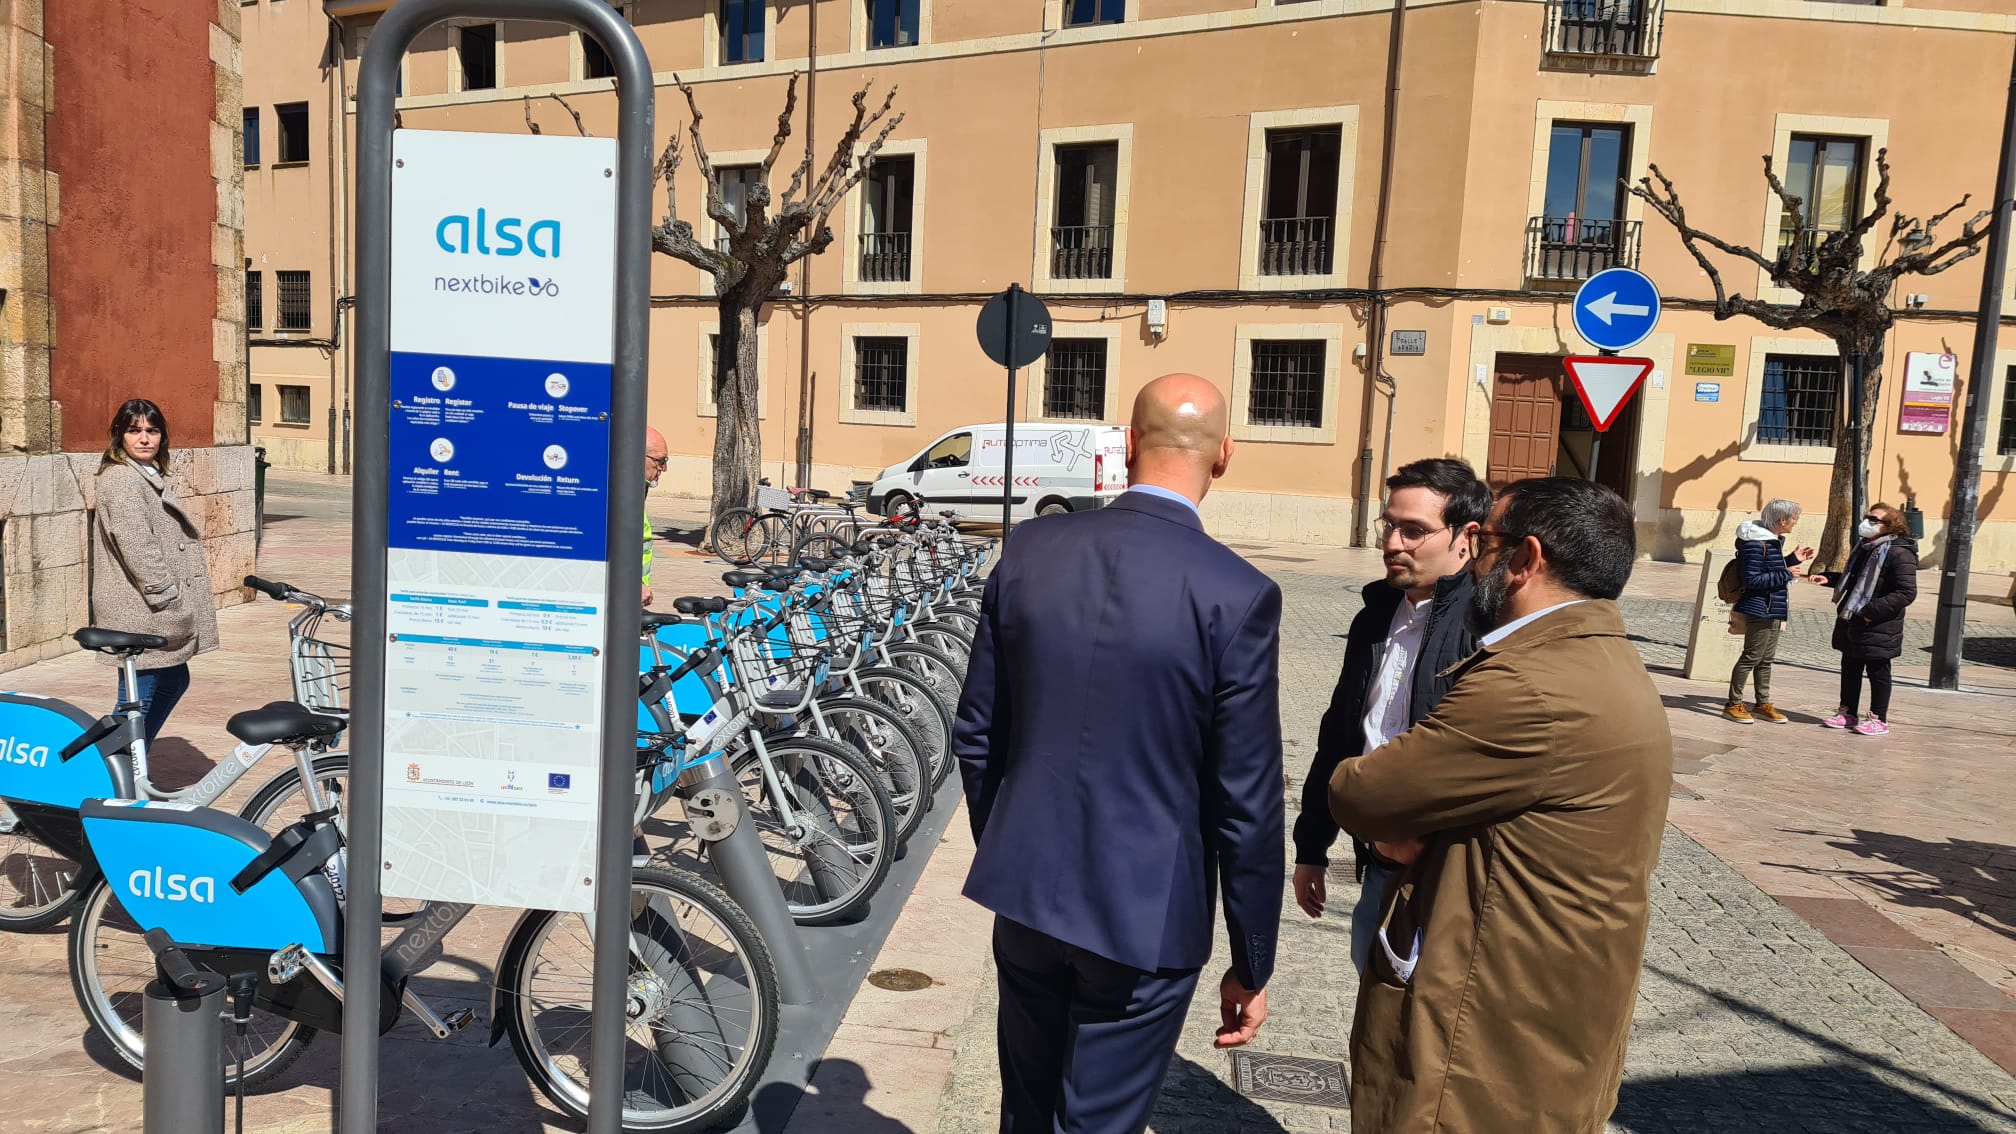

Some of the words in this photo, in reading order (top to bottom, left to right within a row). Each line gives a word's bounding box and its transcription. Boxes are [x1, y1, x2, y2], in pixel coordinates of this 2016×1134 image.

[436, 207, 561, 258] alsa
[434, 274, 525, 295] nextbike
[413, 396, 441, 405] Registro
[445, 398, 473, 407] Register
[507, 401, 528, 409] Pausa
[558, 405, 588, 413] Stopover
[413, 467, 440, 476] Alquiler
[443, 469, 460, 477] Rent
[556, 475, 580, 484] Return
[186, 760, 240, 806] xtbike
[128, 865, 215, 904] alsa
